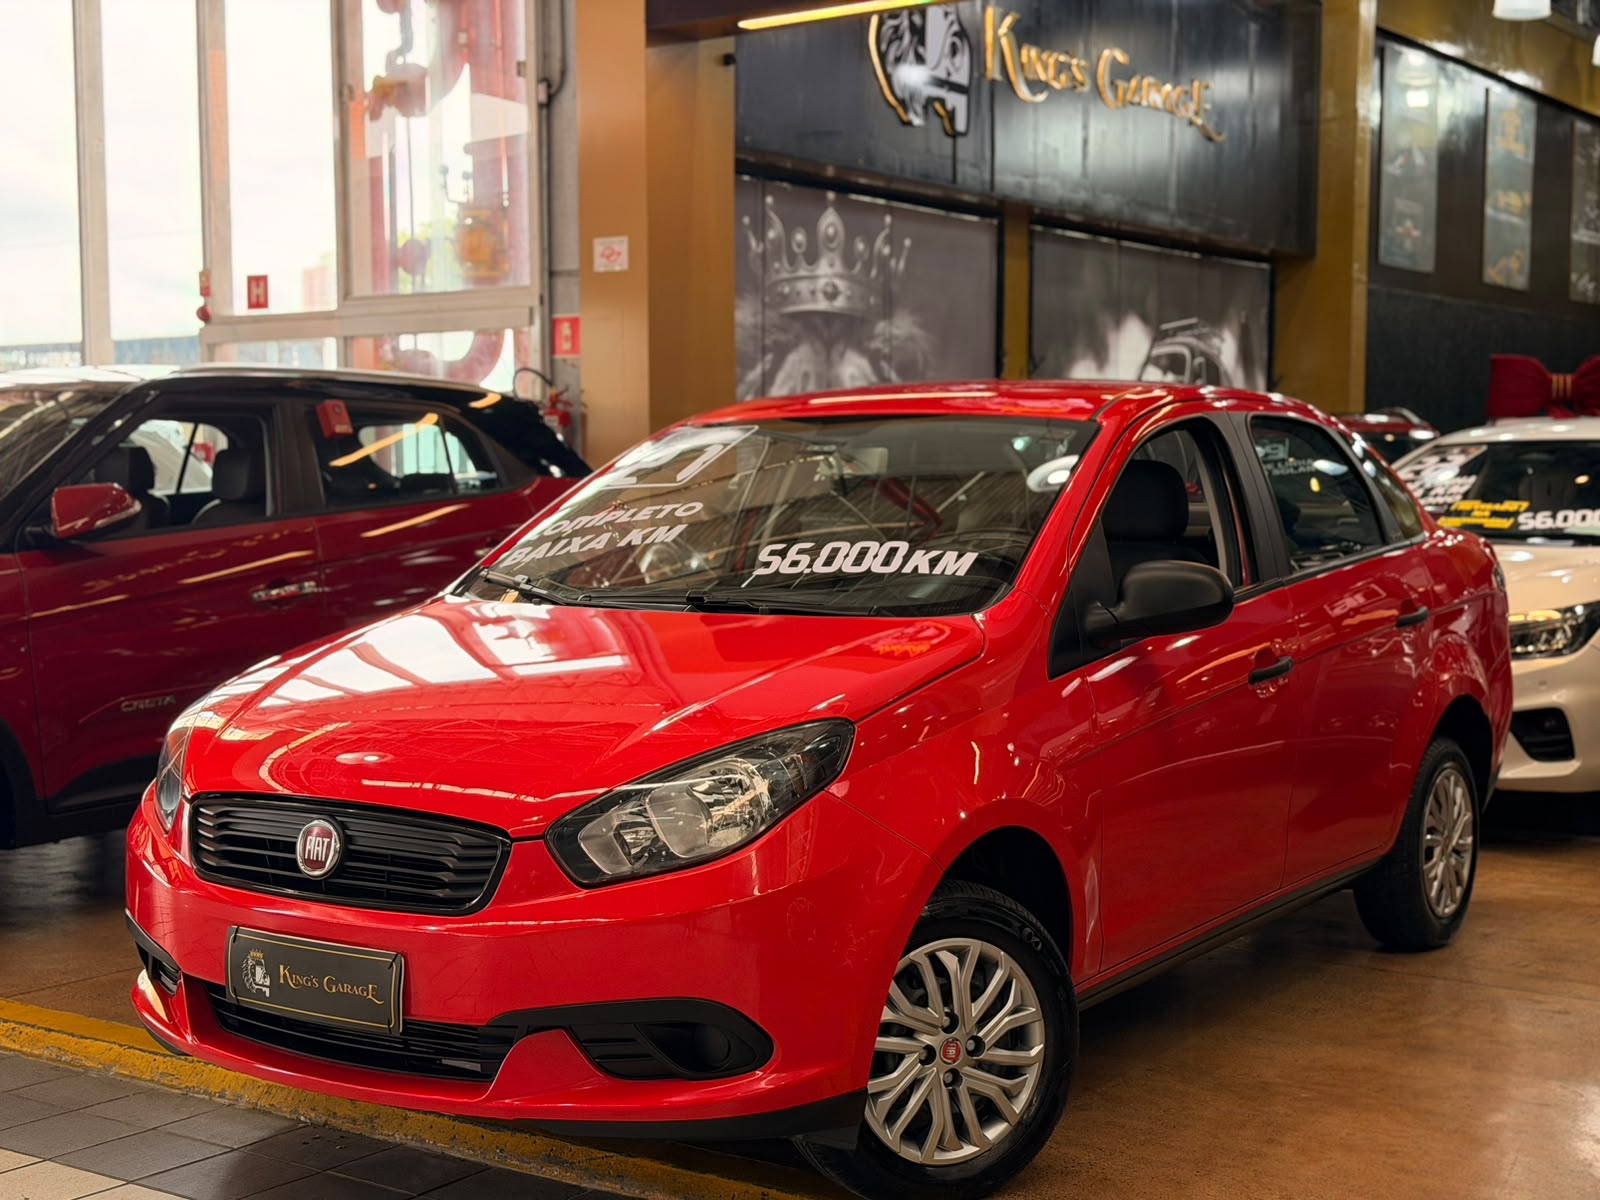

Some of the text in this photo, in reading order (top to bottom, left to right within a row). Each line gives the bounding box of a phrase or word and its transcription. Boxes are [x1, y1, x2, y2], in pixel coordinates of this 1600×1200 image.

[500, 524, 688, 567] BAIXA KM
[304, 835, 331, 862] FIAT
